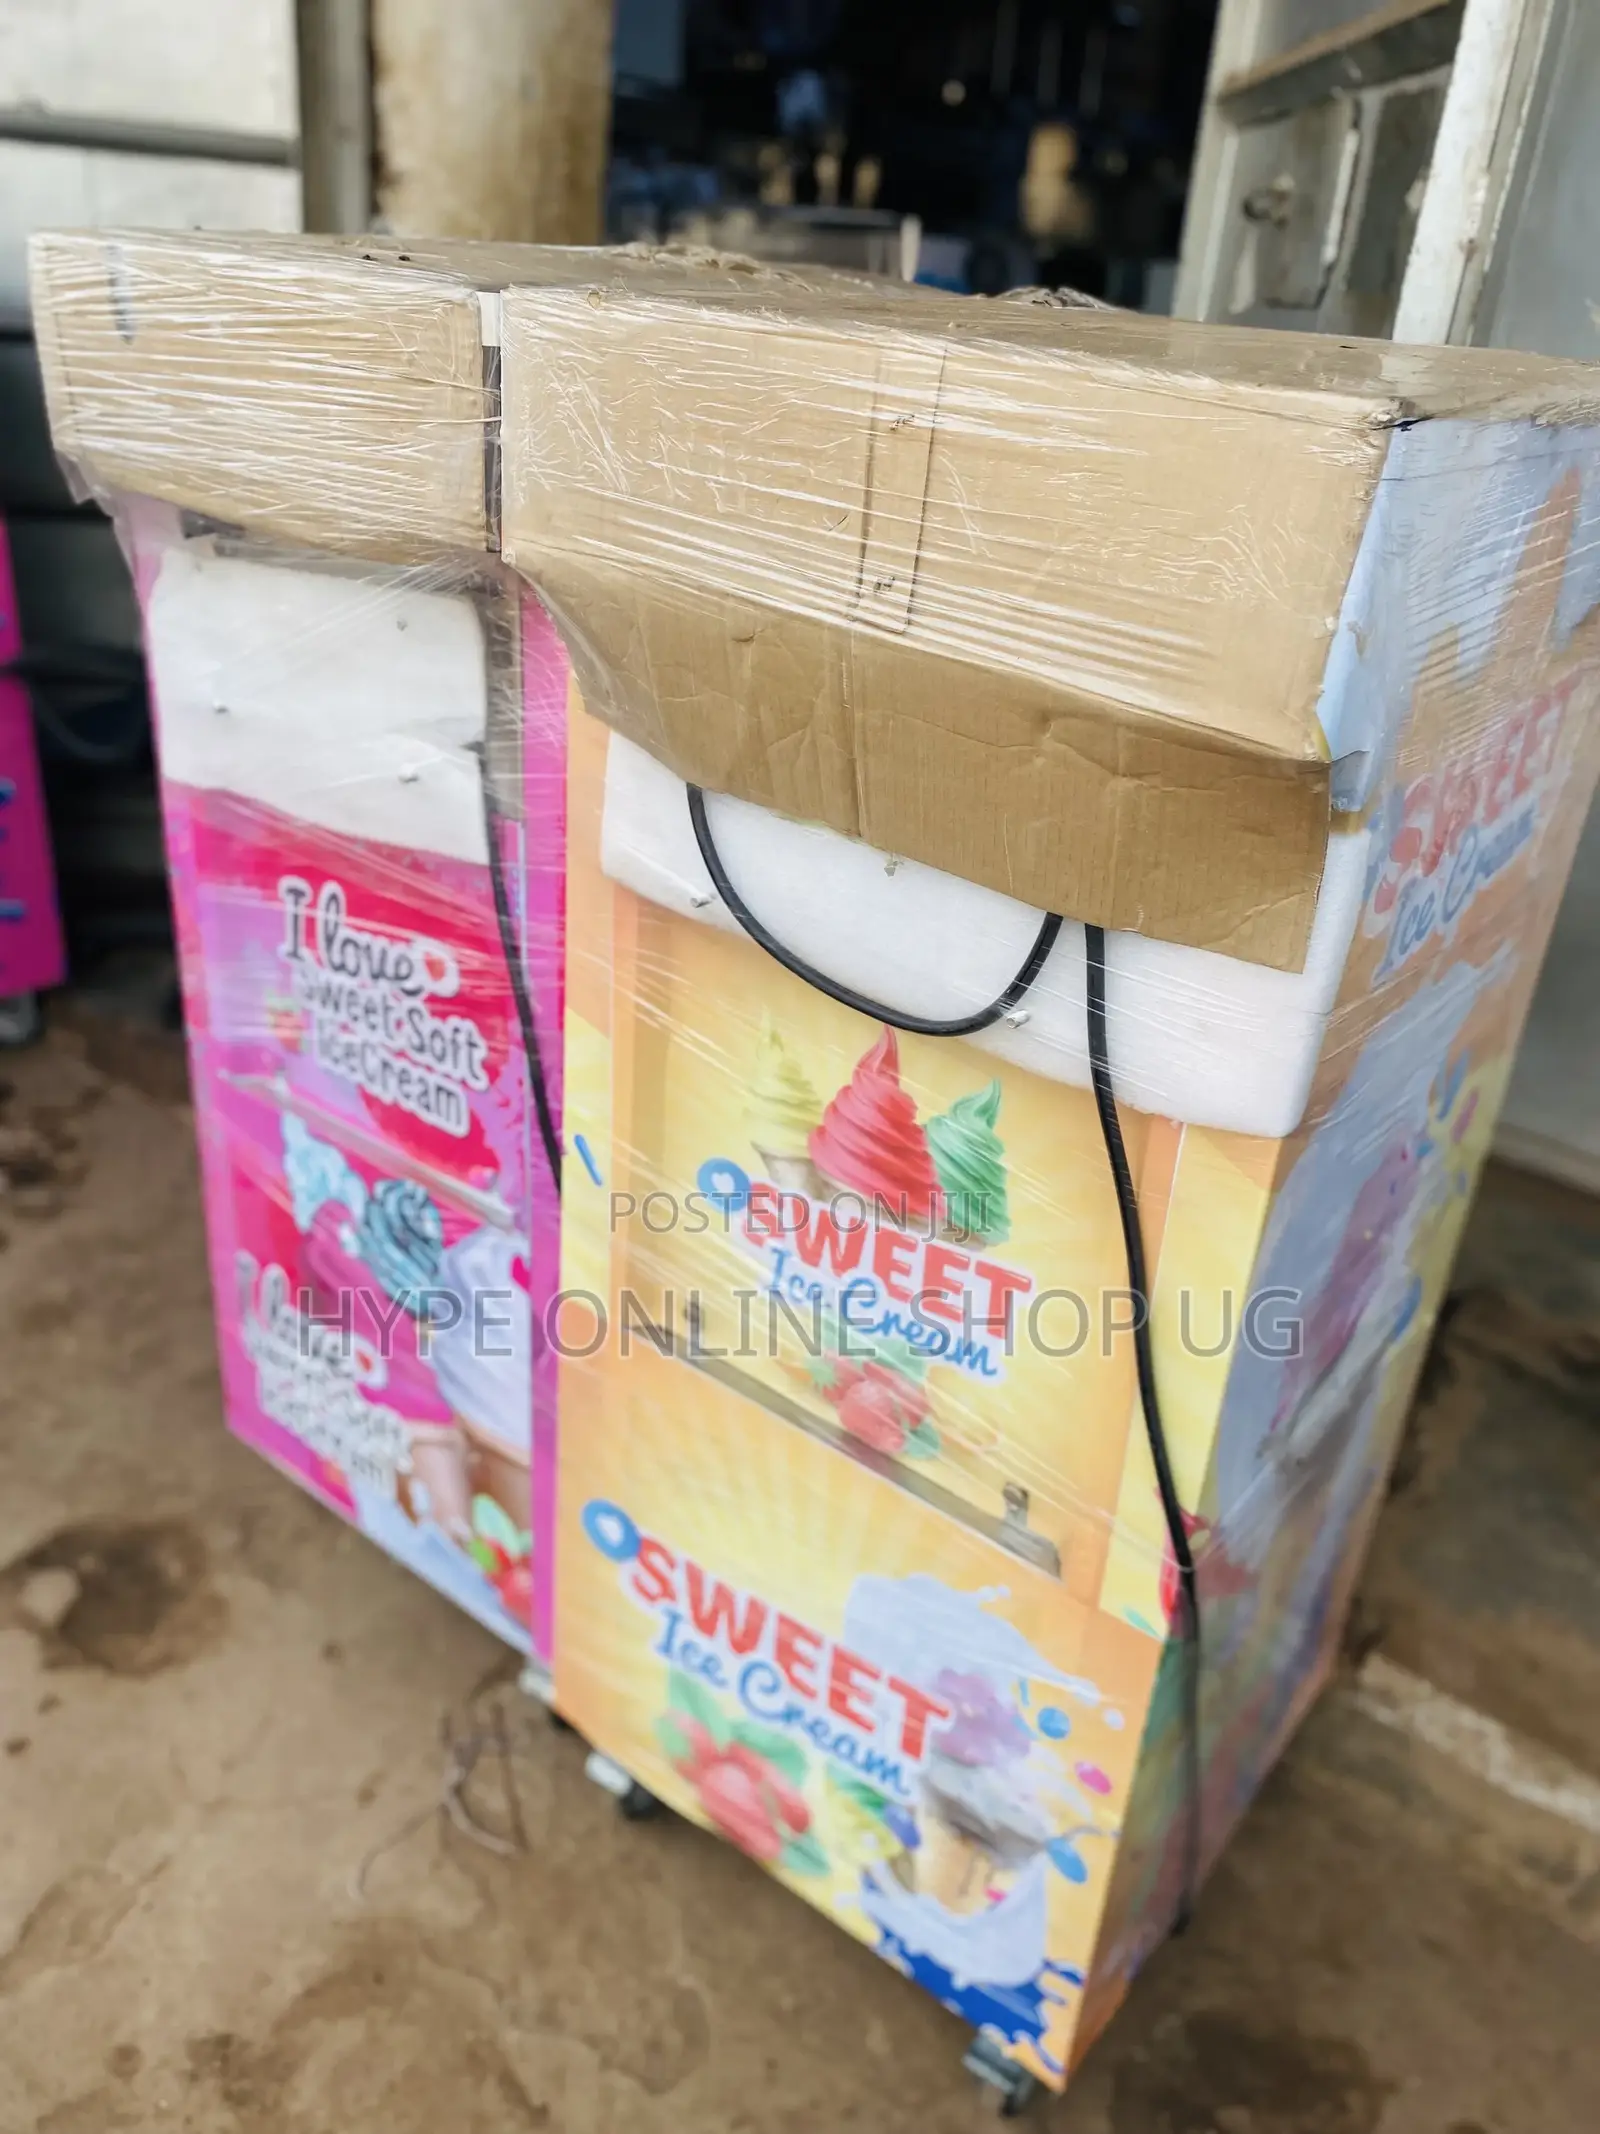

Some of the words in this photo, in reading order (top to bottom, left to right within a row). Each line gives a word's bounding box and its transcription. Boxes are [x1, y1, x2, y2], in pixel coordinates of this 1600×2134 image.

[284, 887, 306, 962] I
[321, 893, 425, 996] love
[407, 1005, 481, 1082] Soft
[742, 1181, 1032, 1340] SWEET
[766, 1247, 832, 1310] Ice
[840, 1277, 998, 1377] Cream
[631, 1536, 950, 1761] SWEET
[653, 1607, 729, 1689] Ice
[738, 1660, 911, 1797] Cream
